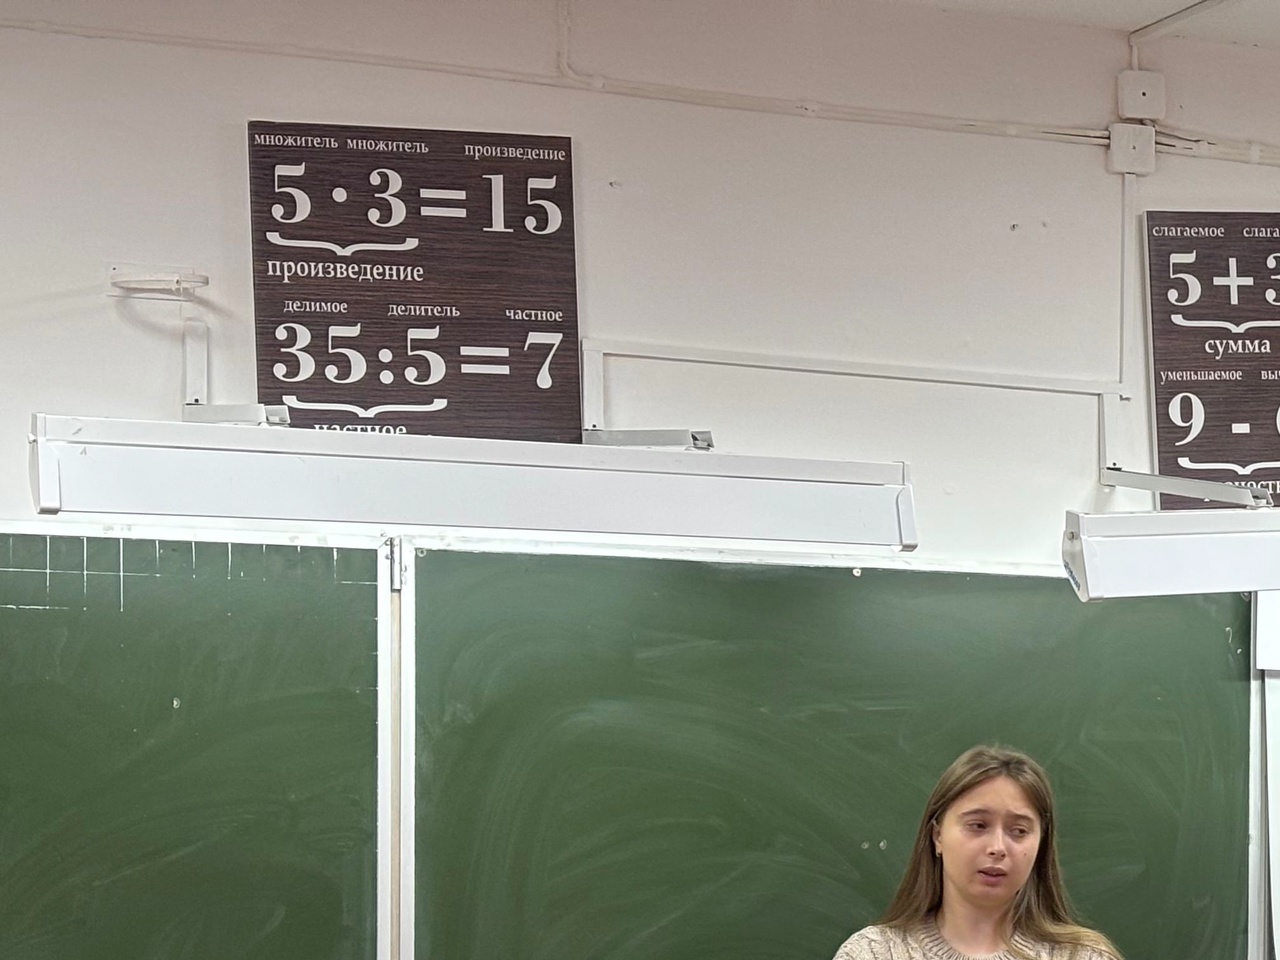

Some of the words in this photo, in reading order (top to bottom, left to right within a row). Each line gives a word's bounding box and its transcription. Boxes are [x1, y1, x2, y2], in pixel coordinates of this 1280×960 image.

[254, 133, 339, 149] множитель
[346, 137, 429, 154] множитель
[464, 143, 566, 161] произведение
[1152, 225, 1226, 238] слагаемое
[266, 259, 424, 283] произведение
[283, 299, 348, 313] делимое
[387, 302, 461, 317] делитель
[505, 307, 563, 322] частное
[1204, 339, 1271, 360] сумма
[1160, 369, 1243, 385] уменьшаемое
